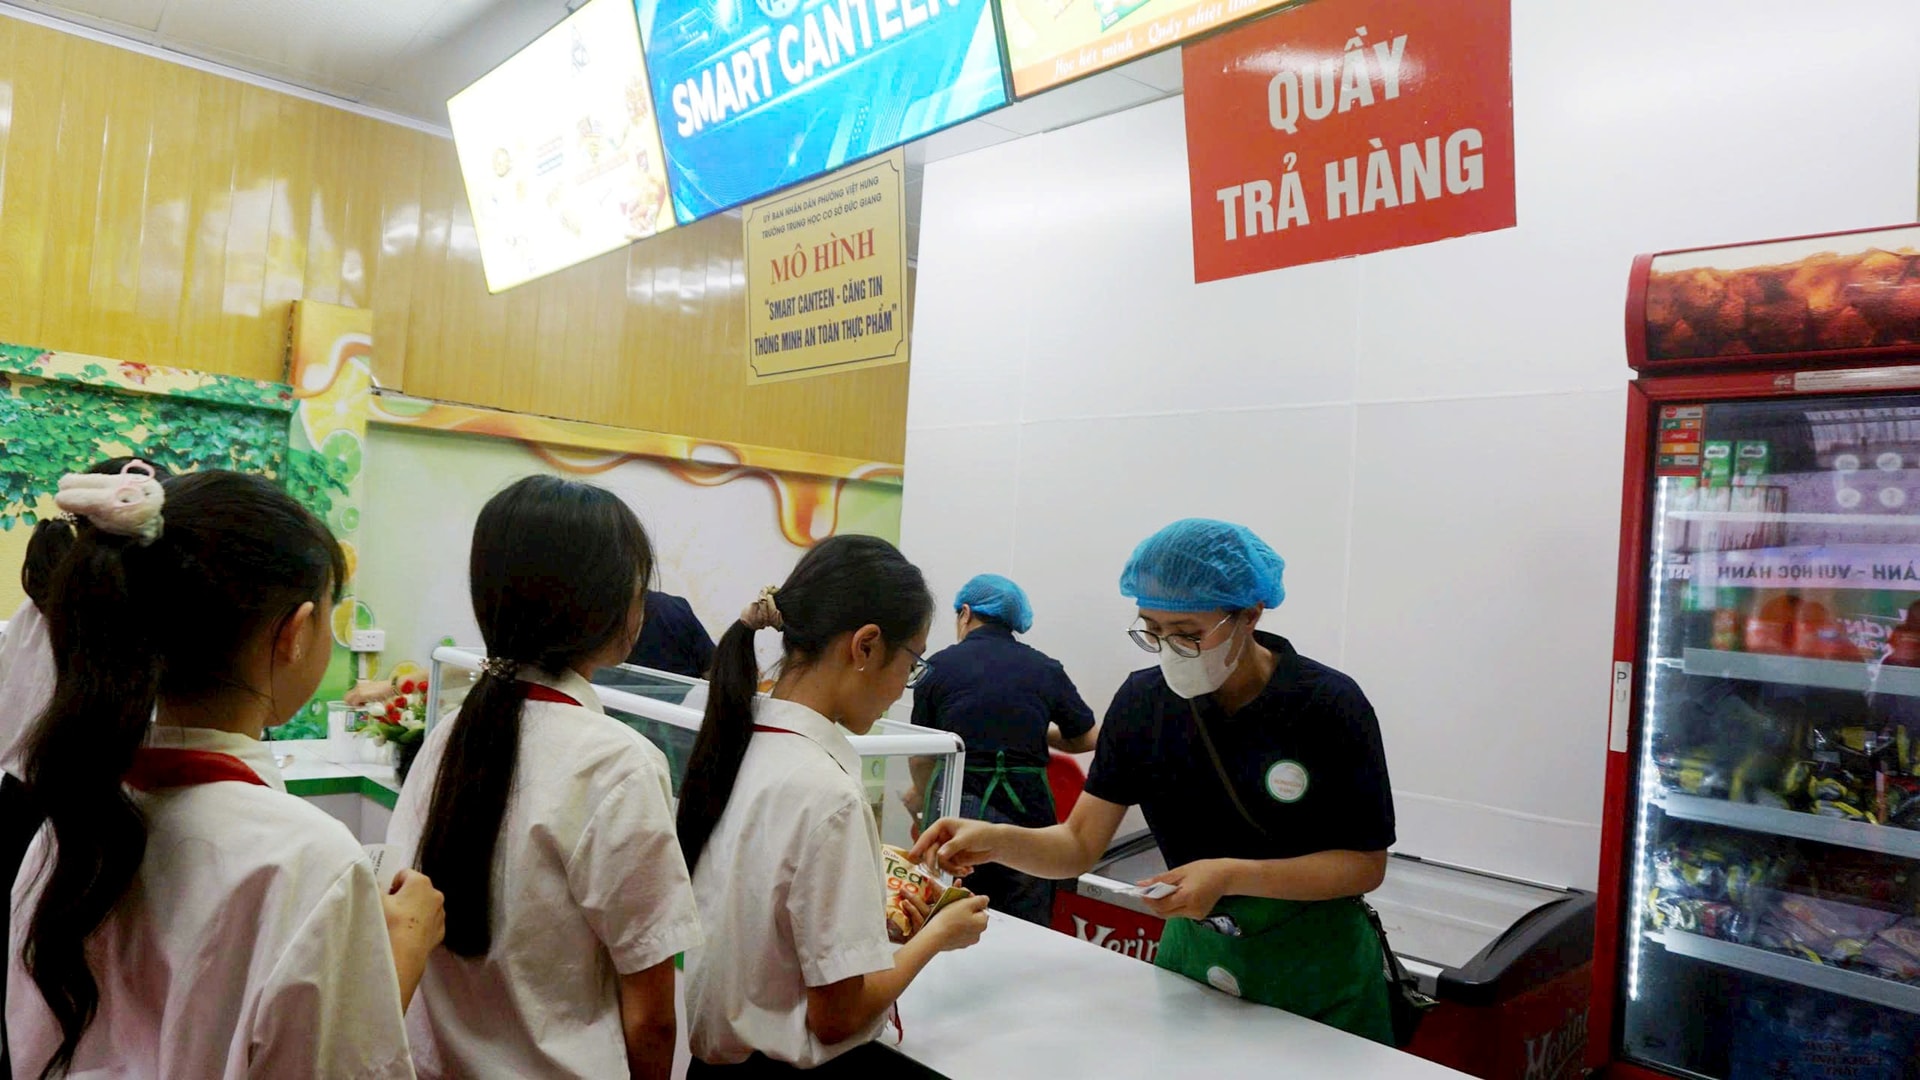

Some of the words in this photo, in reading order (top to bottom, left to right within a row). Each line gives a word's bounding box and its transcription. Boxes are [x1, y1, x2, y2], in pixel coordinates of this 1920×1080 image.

[672, 37, 773, 138] SMART
[778, 0, 961, 84] CANTEE
[1268, 26, 1408, 134] QUẦY
[1217, 152, 1310, 241] TRẢ
[1325, 128, 1484, 221] HÀNG
[772, 209, 784, 220] BAN
[786, 218, 806, 231] TRUNG
[807, 213, 821, 226] HỌC
[860, 193, 882, 207] GIANG
[771, 243, 807, 284] MÔ
[813, 228, 875, 273] HÌNH
[798, 287, 834, 314] CANTEEN
[842, 278, 866, 304] CĂNG
[869, 275, 883, 298] TIN
[754, 332, 779, 356] THÔNG
[781, 329, 802, 351] MINH
[804, 326, 816, 347] AN
[818, 319, 839, 344] TOÀN
[842, 315, 864, 343] THỰC
[885, 857, 922, 886] Tea
